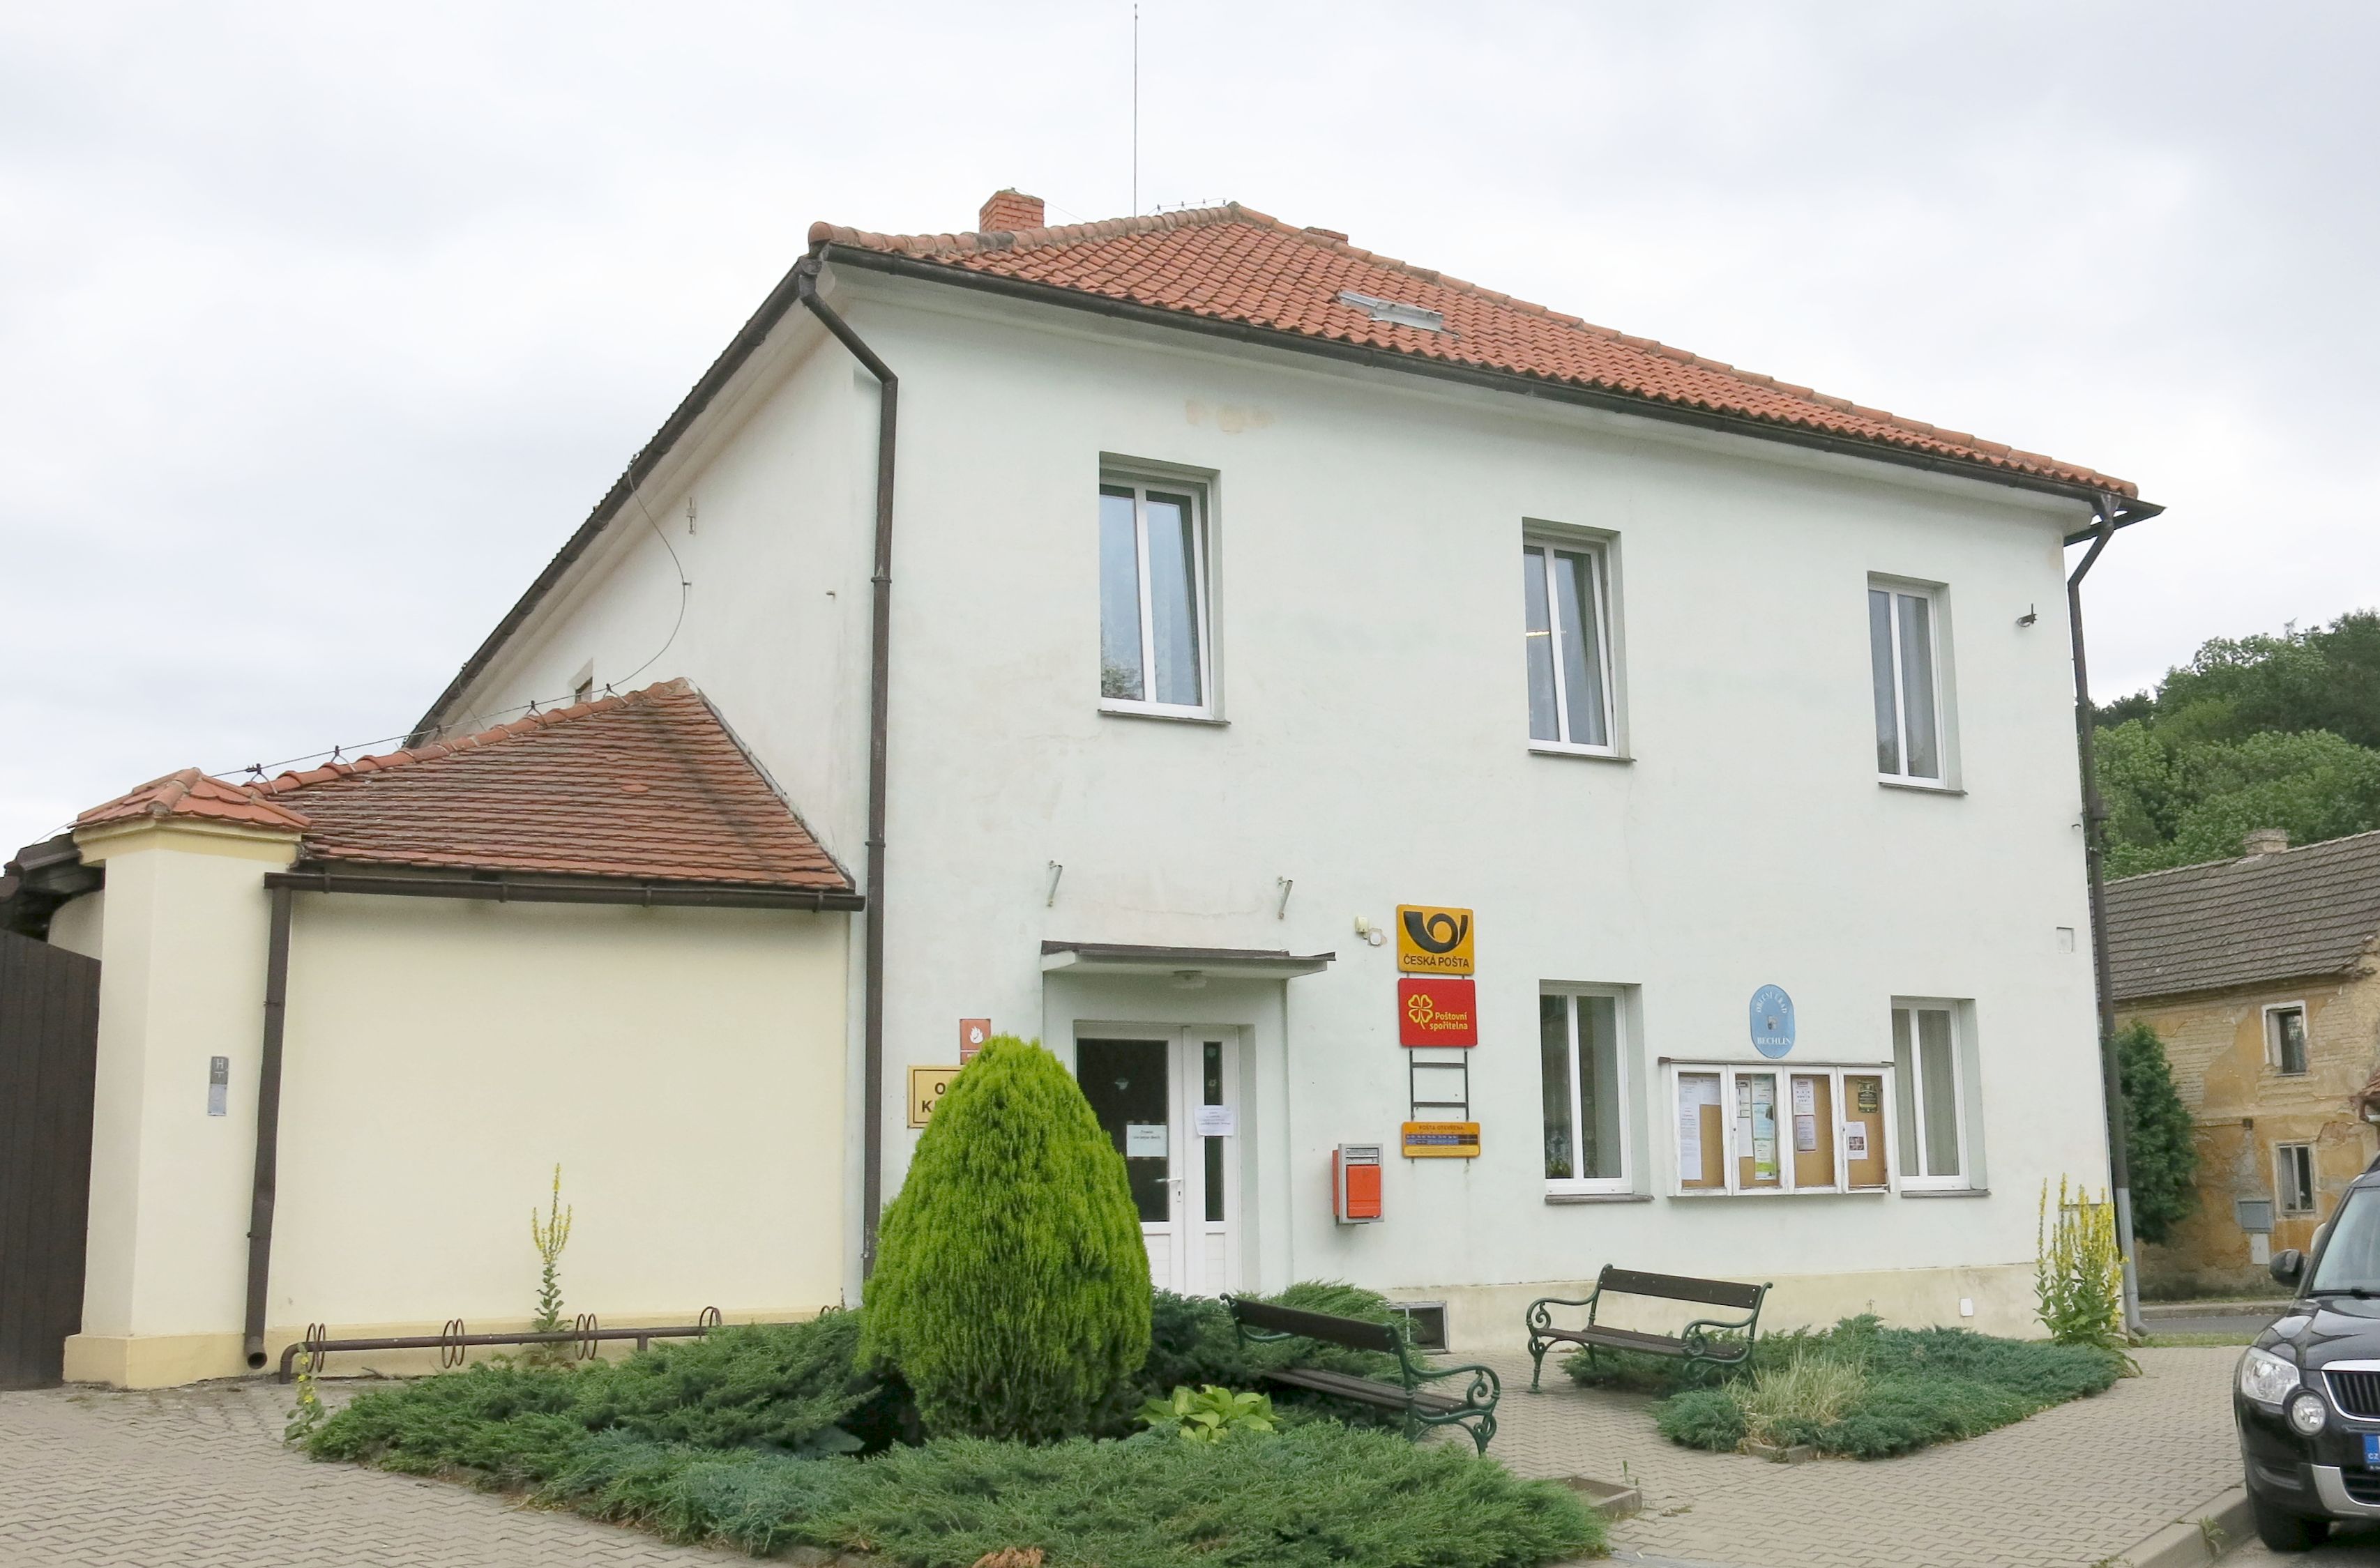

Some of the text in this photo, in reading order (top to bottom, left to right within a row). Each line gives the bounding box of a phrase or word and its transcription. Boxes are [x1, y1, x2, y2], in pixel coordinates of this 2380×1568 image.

[1403, 954, 1469, 968] ČESKÁ POŠTA
[1435, 1012, 1467, 1020] Poštovní
[1430, 1021, 1468, 1031] spořitelna
